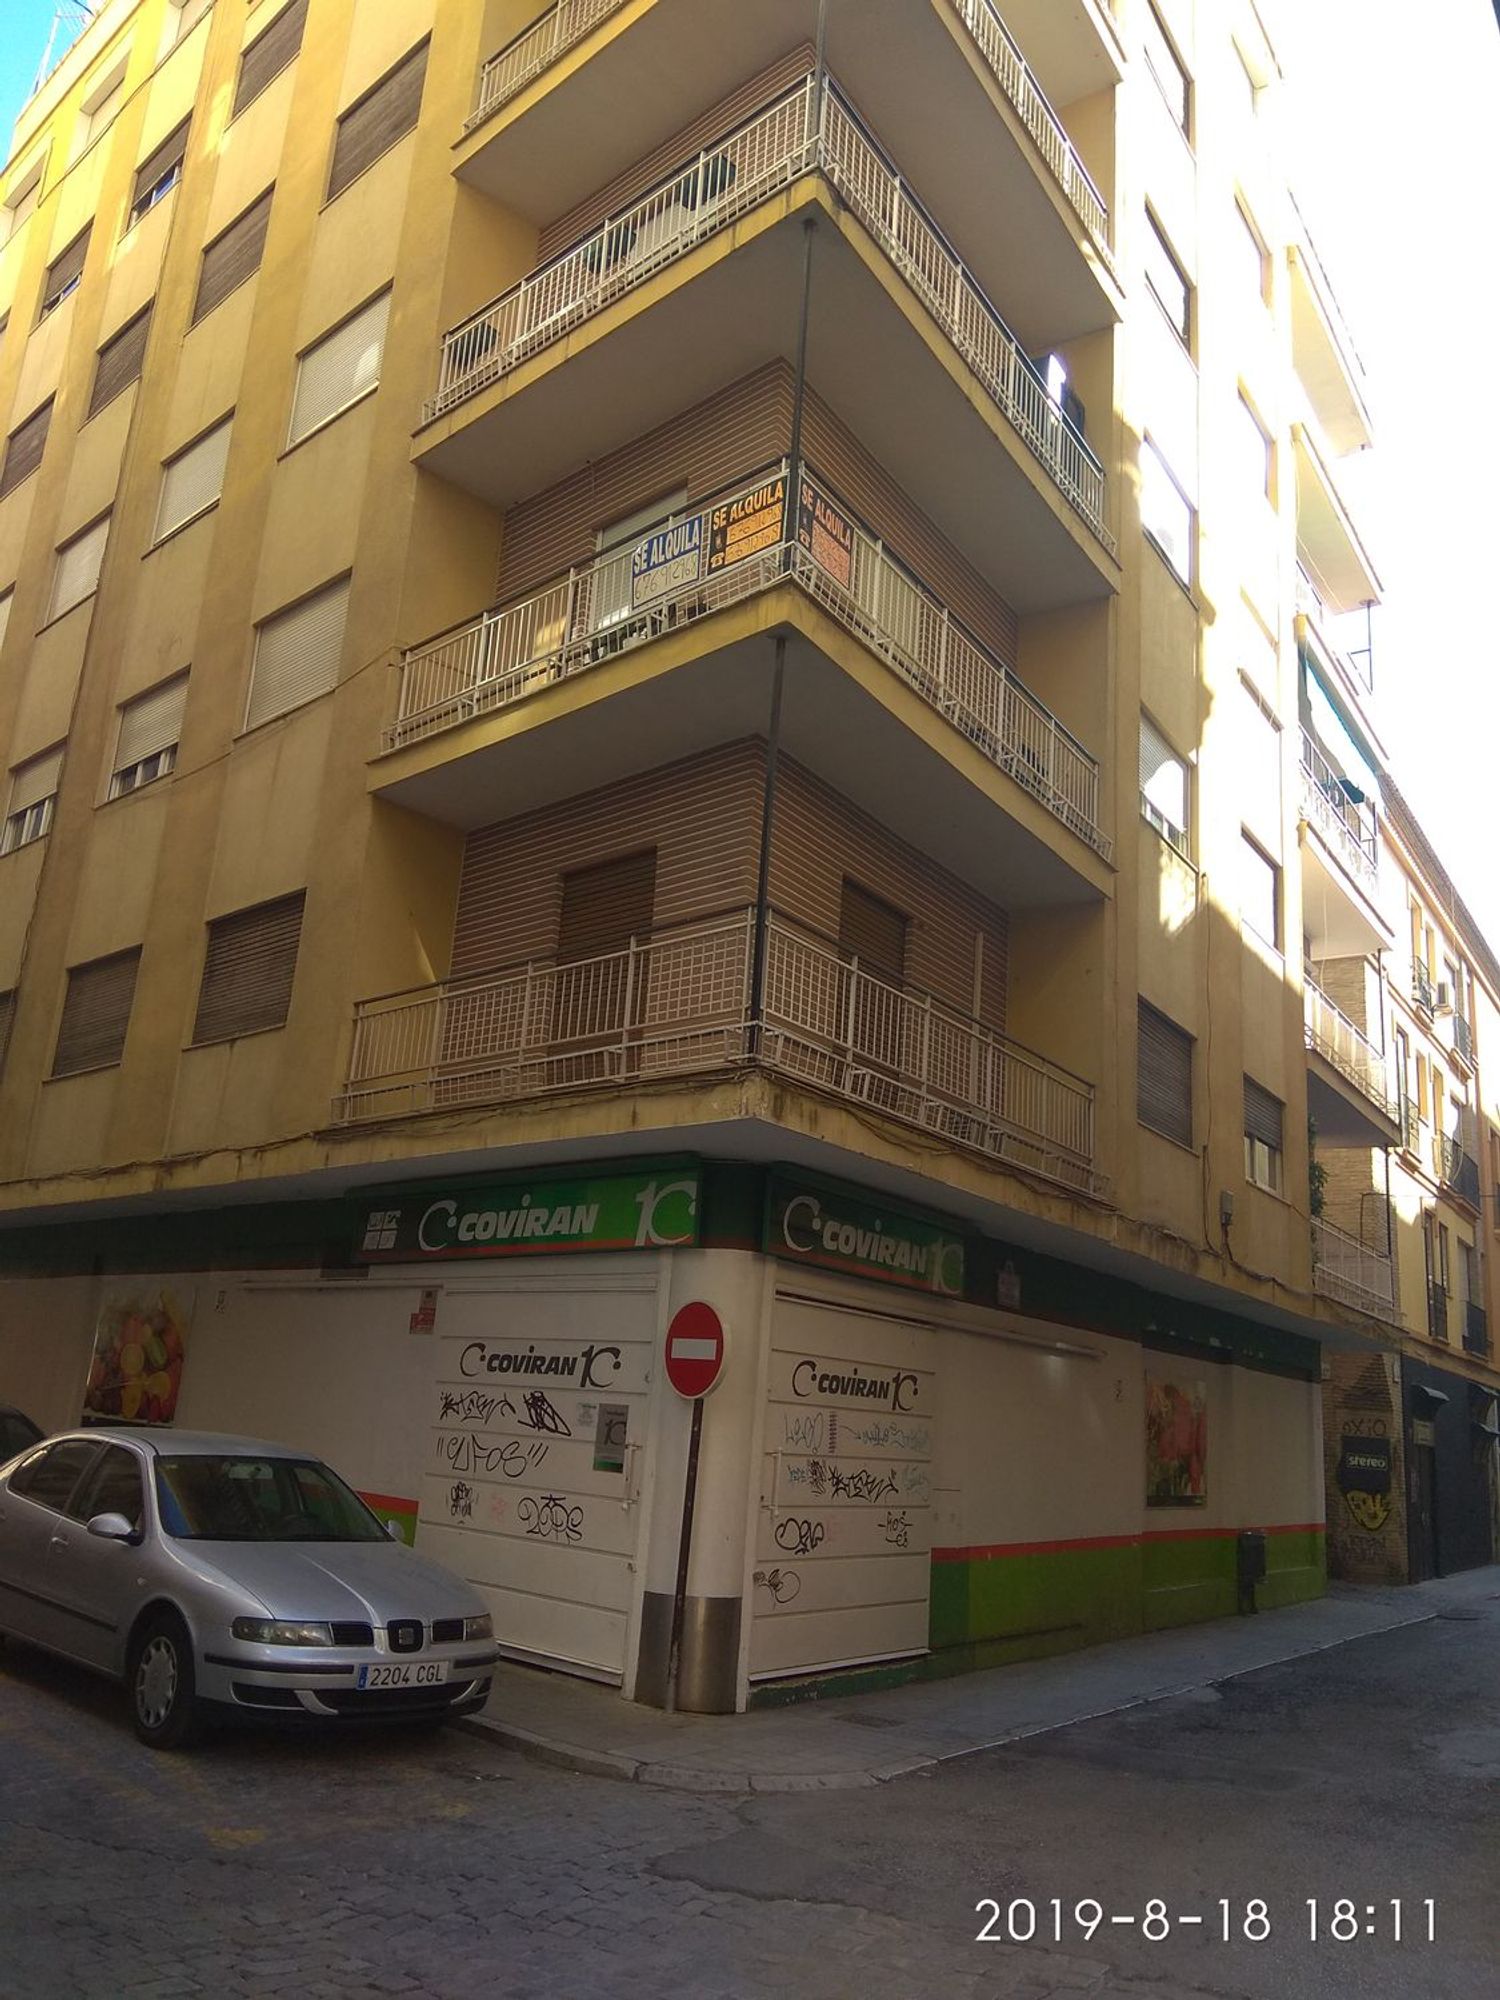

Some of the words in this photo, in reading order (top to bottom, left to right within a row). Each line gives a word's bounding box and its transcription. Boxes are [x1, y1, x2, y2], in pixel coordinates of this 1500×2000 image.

[713, 506, 728, 530] SE
[730, 480, 784, 522] ALQUILA
[801, 483, 814, 512] SE
[815, 498, 851, 551] ALQUILA
[634, 542, 649, 575] SE
[650, 519, 700, 567] ALQUILA
[370, 1666, 410, 1686] 2204
[416, 1663, 443, 1684] CGL
